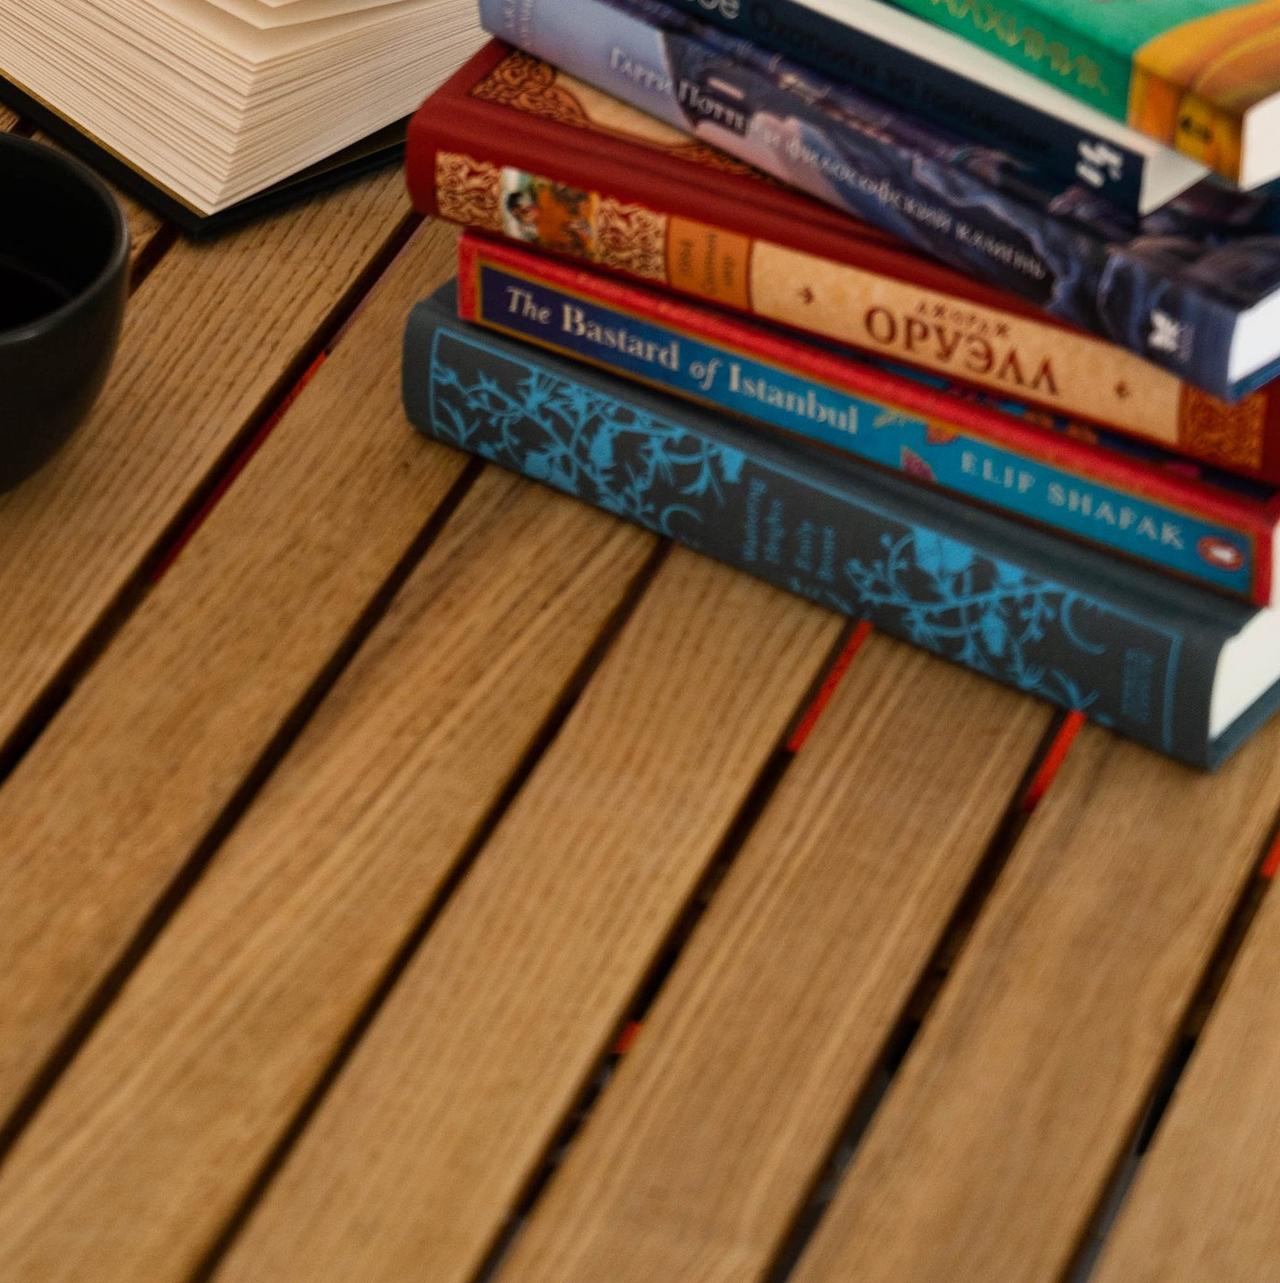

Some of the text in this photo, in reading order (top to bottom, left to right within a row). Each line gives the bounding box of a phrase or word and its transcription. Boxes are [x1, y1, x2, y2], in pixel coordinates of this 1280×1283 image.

[505, 284, 860, 435] The Bastard of Istanbul
[864, 304, 1061, 397] ОРУЭЛЛ
[960, 449, 1186, 551] ELIF SHAFAK
